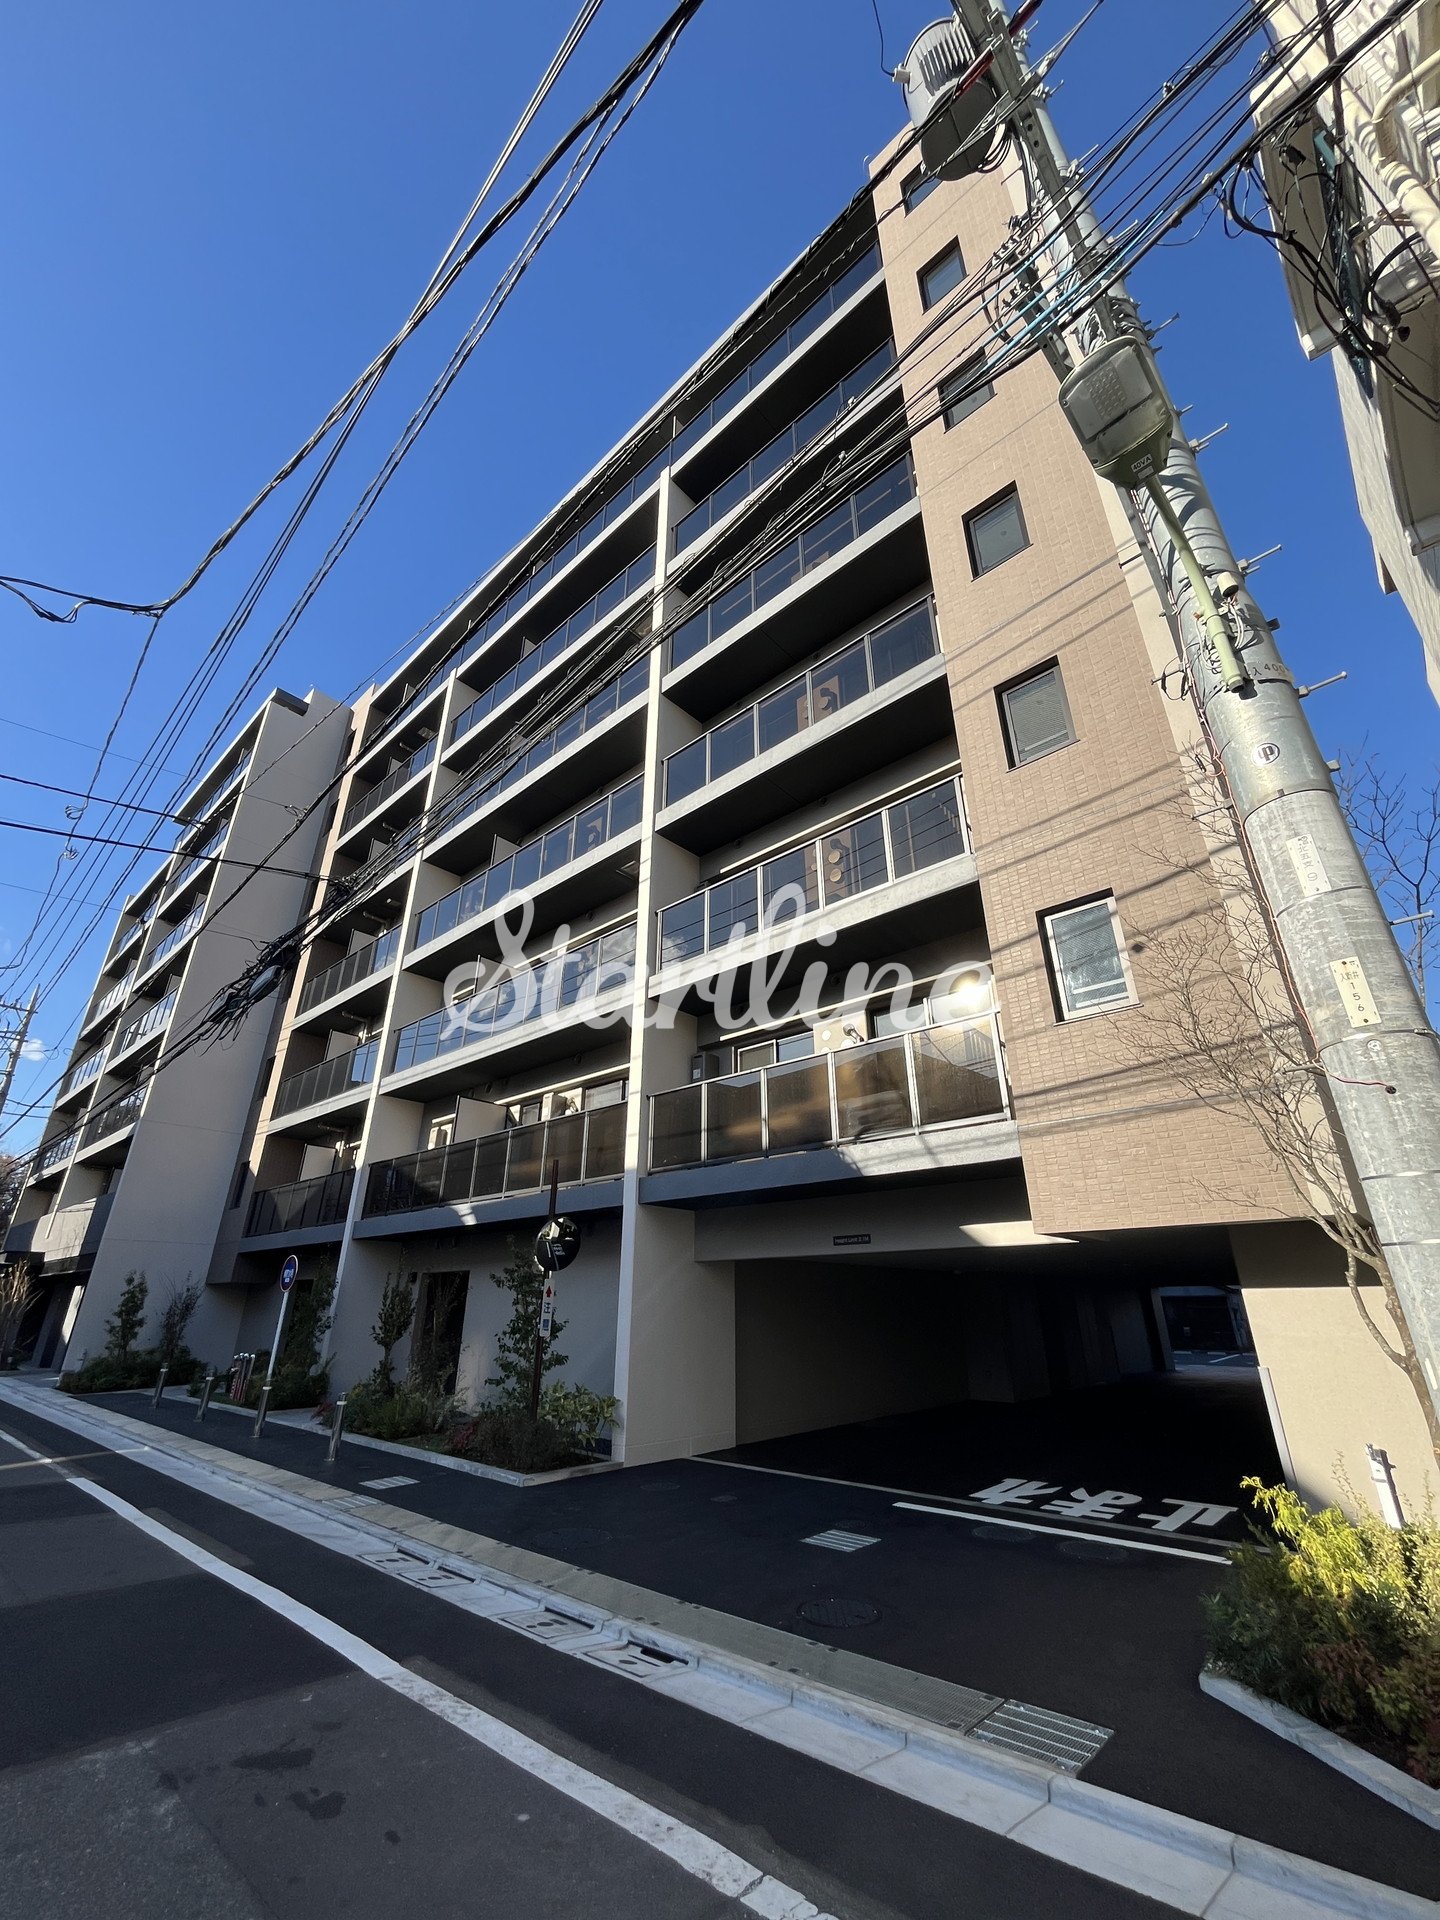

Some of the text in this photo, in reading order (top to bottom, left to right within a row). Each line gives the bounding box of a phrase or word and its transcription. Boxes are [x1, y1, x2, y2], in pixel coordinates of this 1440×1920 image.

[1133, 456, 1151, 470] 40VA
[1350, 982, 1365, 1012] 156
[969, 1478, 1238, 1532] 止まれ
